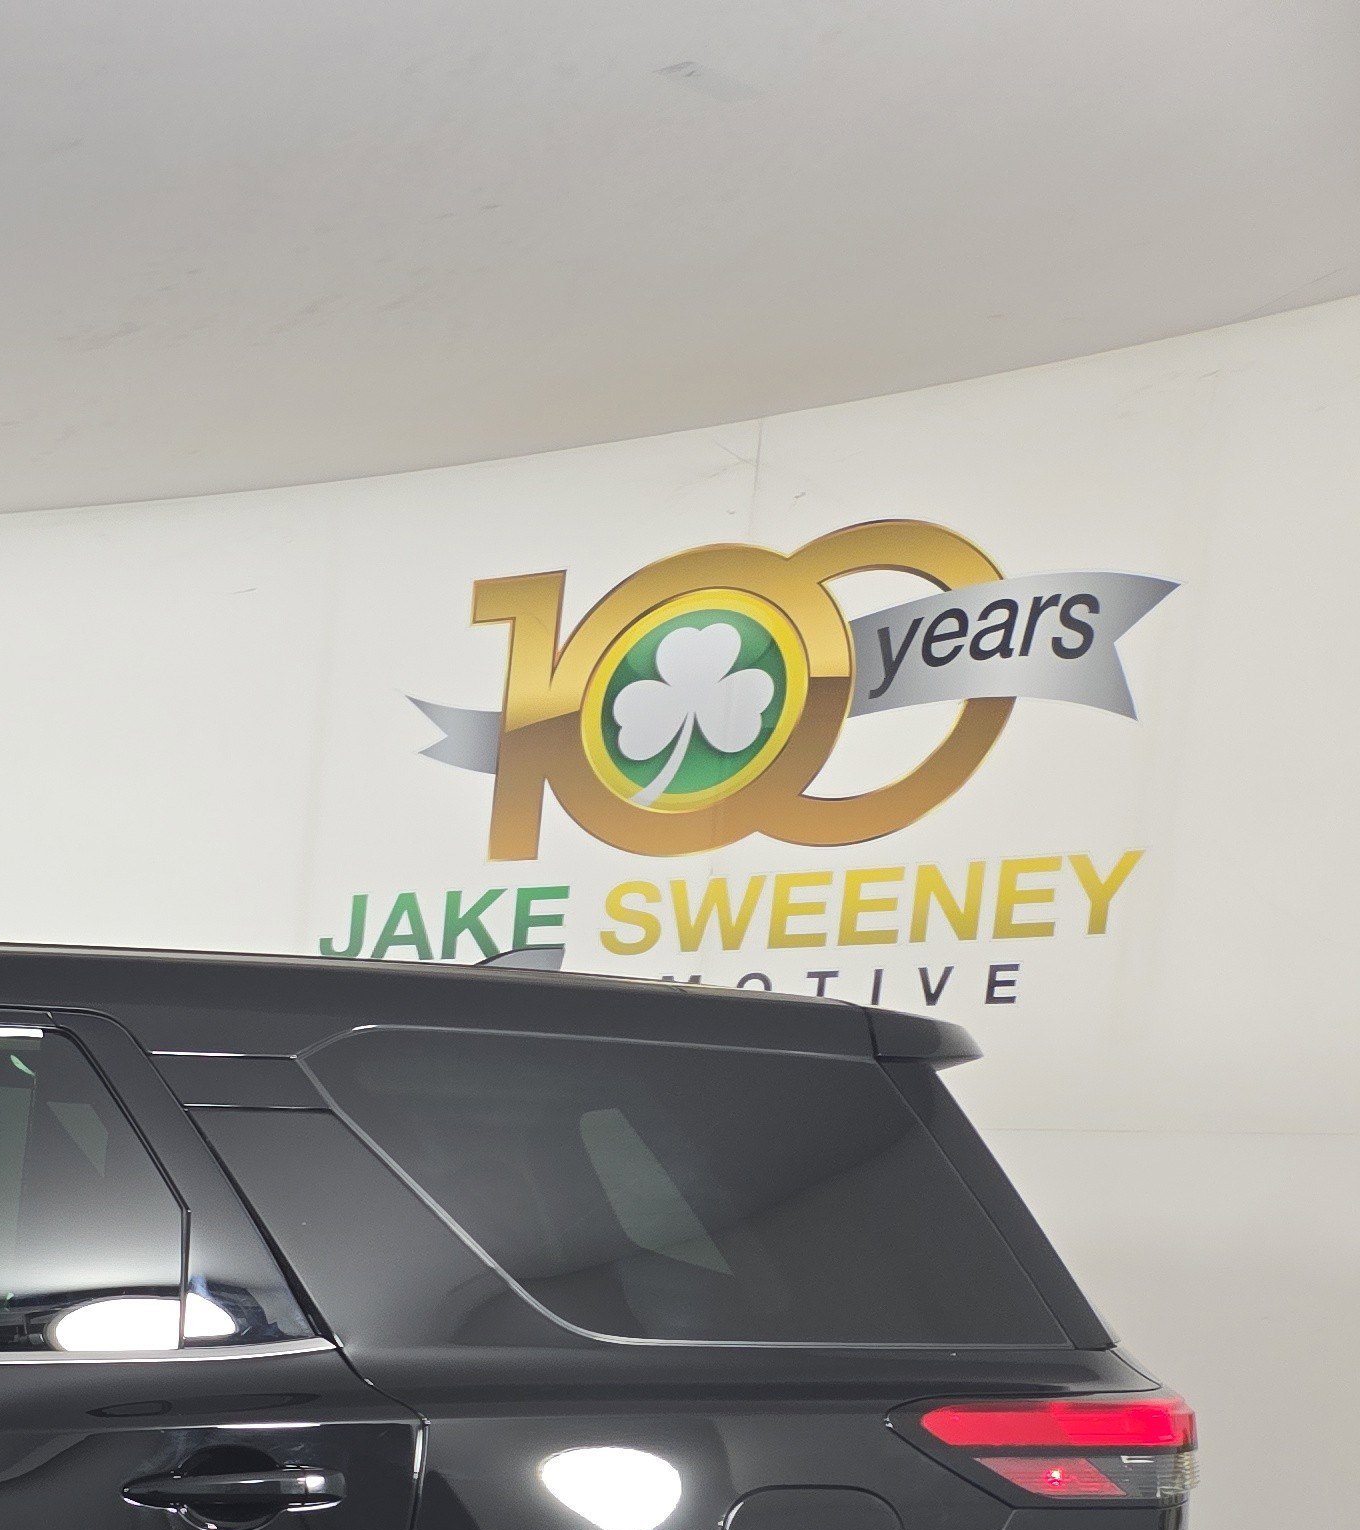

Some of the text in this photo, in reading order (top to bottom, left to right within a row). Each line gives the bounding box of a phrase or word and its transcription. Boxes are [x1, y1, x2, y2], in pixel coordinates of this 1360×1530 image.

[471, 518, 1016, 862] 100
[867, 587, 1101, 700] years
[319, 849, 1145, 960] JAKE SWEENEY
